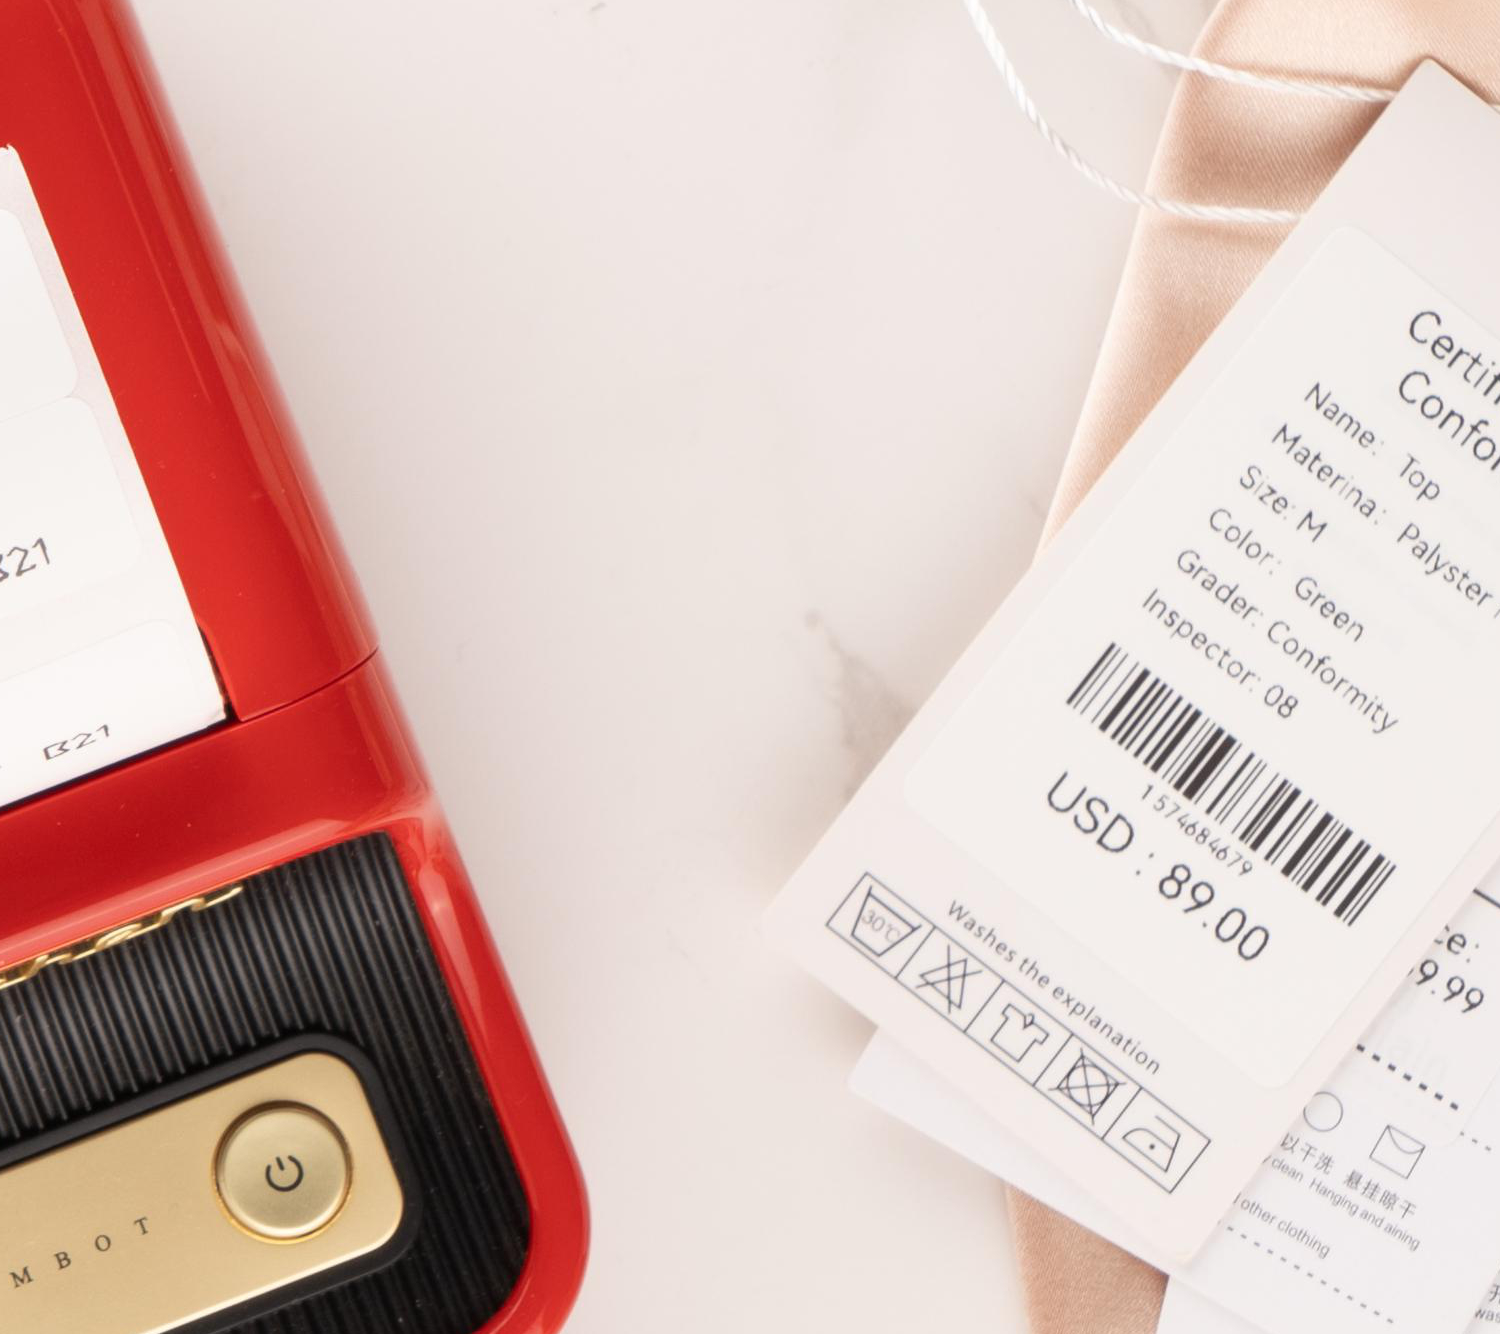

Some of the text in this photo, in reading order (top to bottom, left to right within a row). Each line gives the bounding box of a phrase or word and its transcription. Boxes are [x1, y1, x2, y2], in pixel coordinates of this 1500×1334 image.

[1239, 466, 1327, 543] Size: M
[1305, 383, 1441, 502] Name: Top
[1209, 508, 1365, 642] Color: Green
[1272, 425, 1386, 525] Materina:
[1397, 523, 1493, 606] Palyster
[1143, 588, 1299, 719] Inspector: 08
[1177, 549, 1398, 734] Grader: Conformity
[41, 723, 111, 761] B21
[1045, 771, 1134, 854] USD
[1159, 864, 1270, 961] 89.00
[948, 900, 1161, 1075] Washes the explanation
[1408, 959, 1485, 1013] 9.99
[1241, 1199, 1331, 1259] other clothing
[1272, 1155, 1304, 1182] clean
[1309, 1177, 1359, 1217] Hanging
[1359, 1204, 1383, 1229] and
